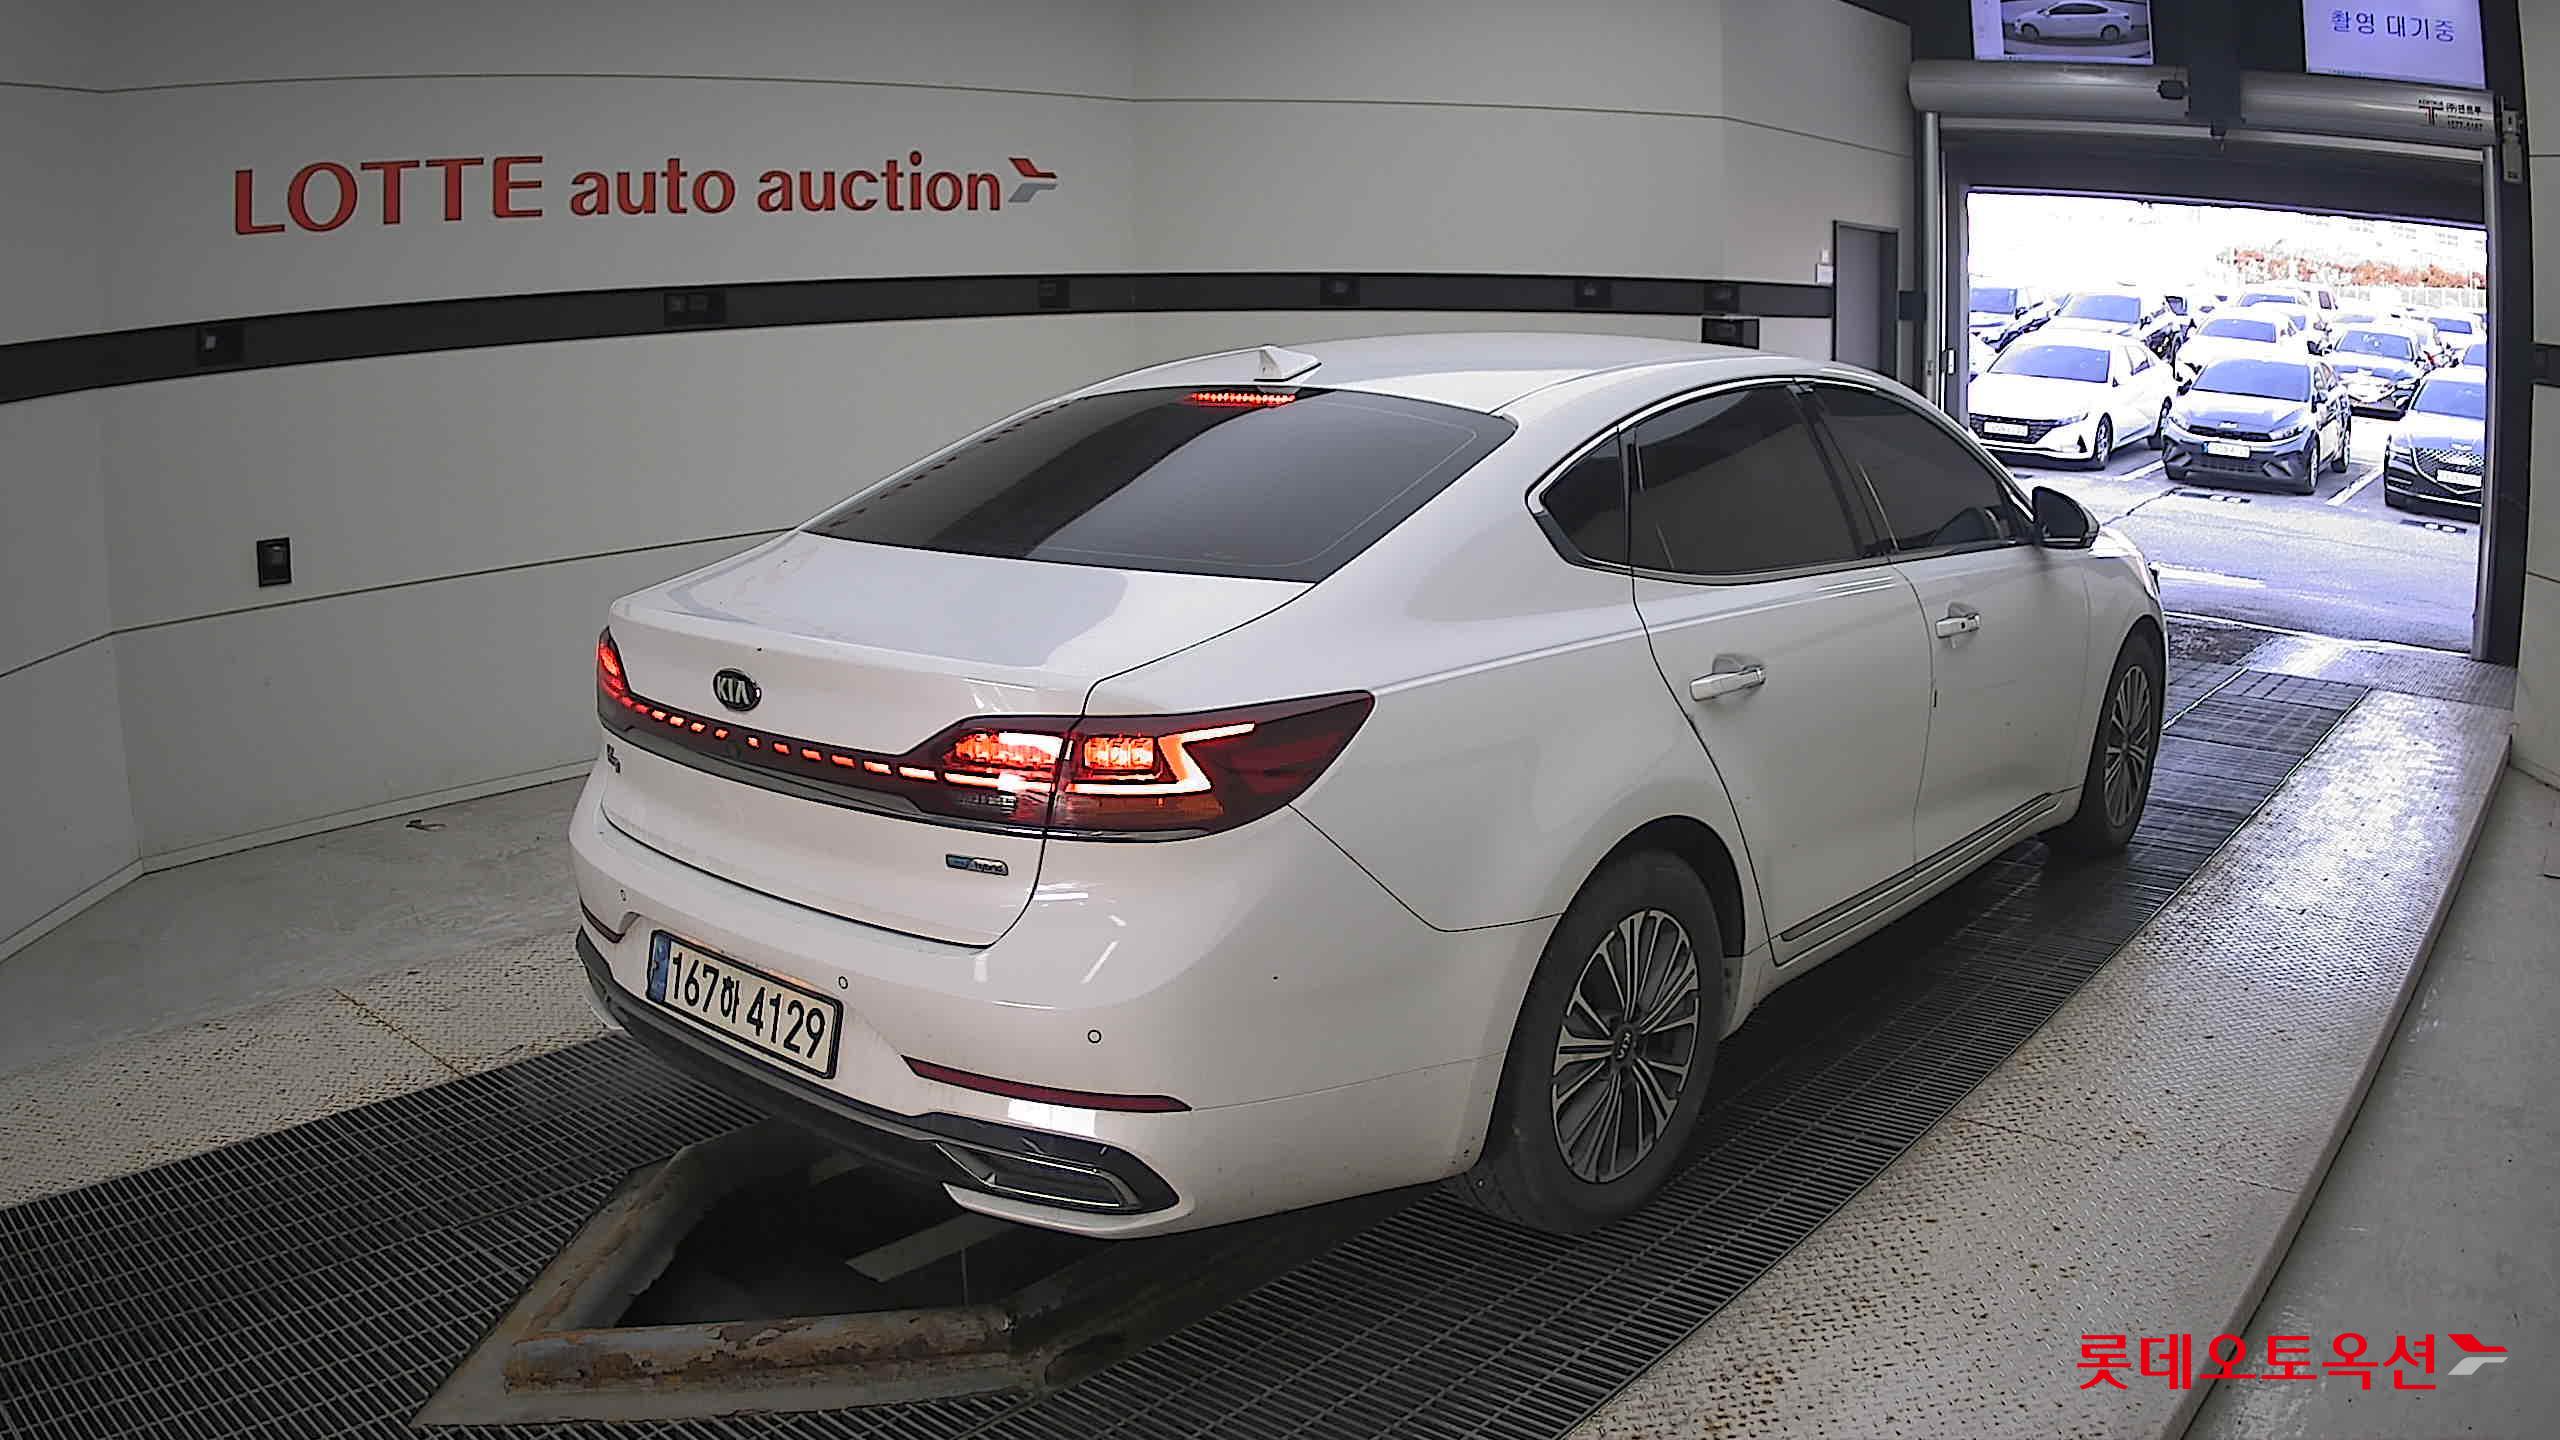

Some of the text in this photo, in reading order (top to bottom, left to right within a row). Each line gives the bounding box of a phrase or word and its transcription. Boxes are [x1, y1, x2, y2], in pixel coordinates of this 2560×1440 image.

[2332, 10, 2375, 34] 촬영
[235, 150, 1001, 235] LOTTE auto auction
[717, 676, 750, 704] KIA
[673, 952, 826, 1059] 167하 4129
